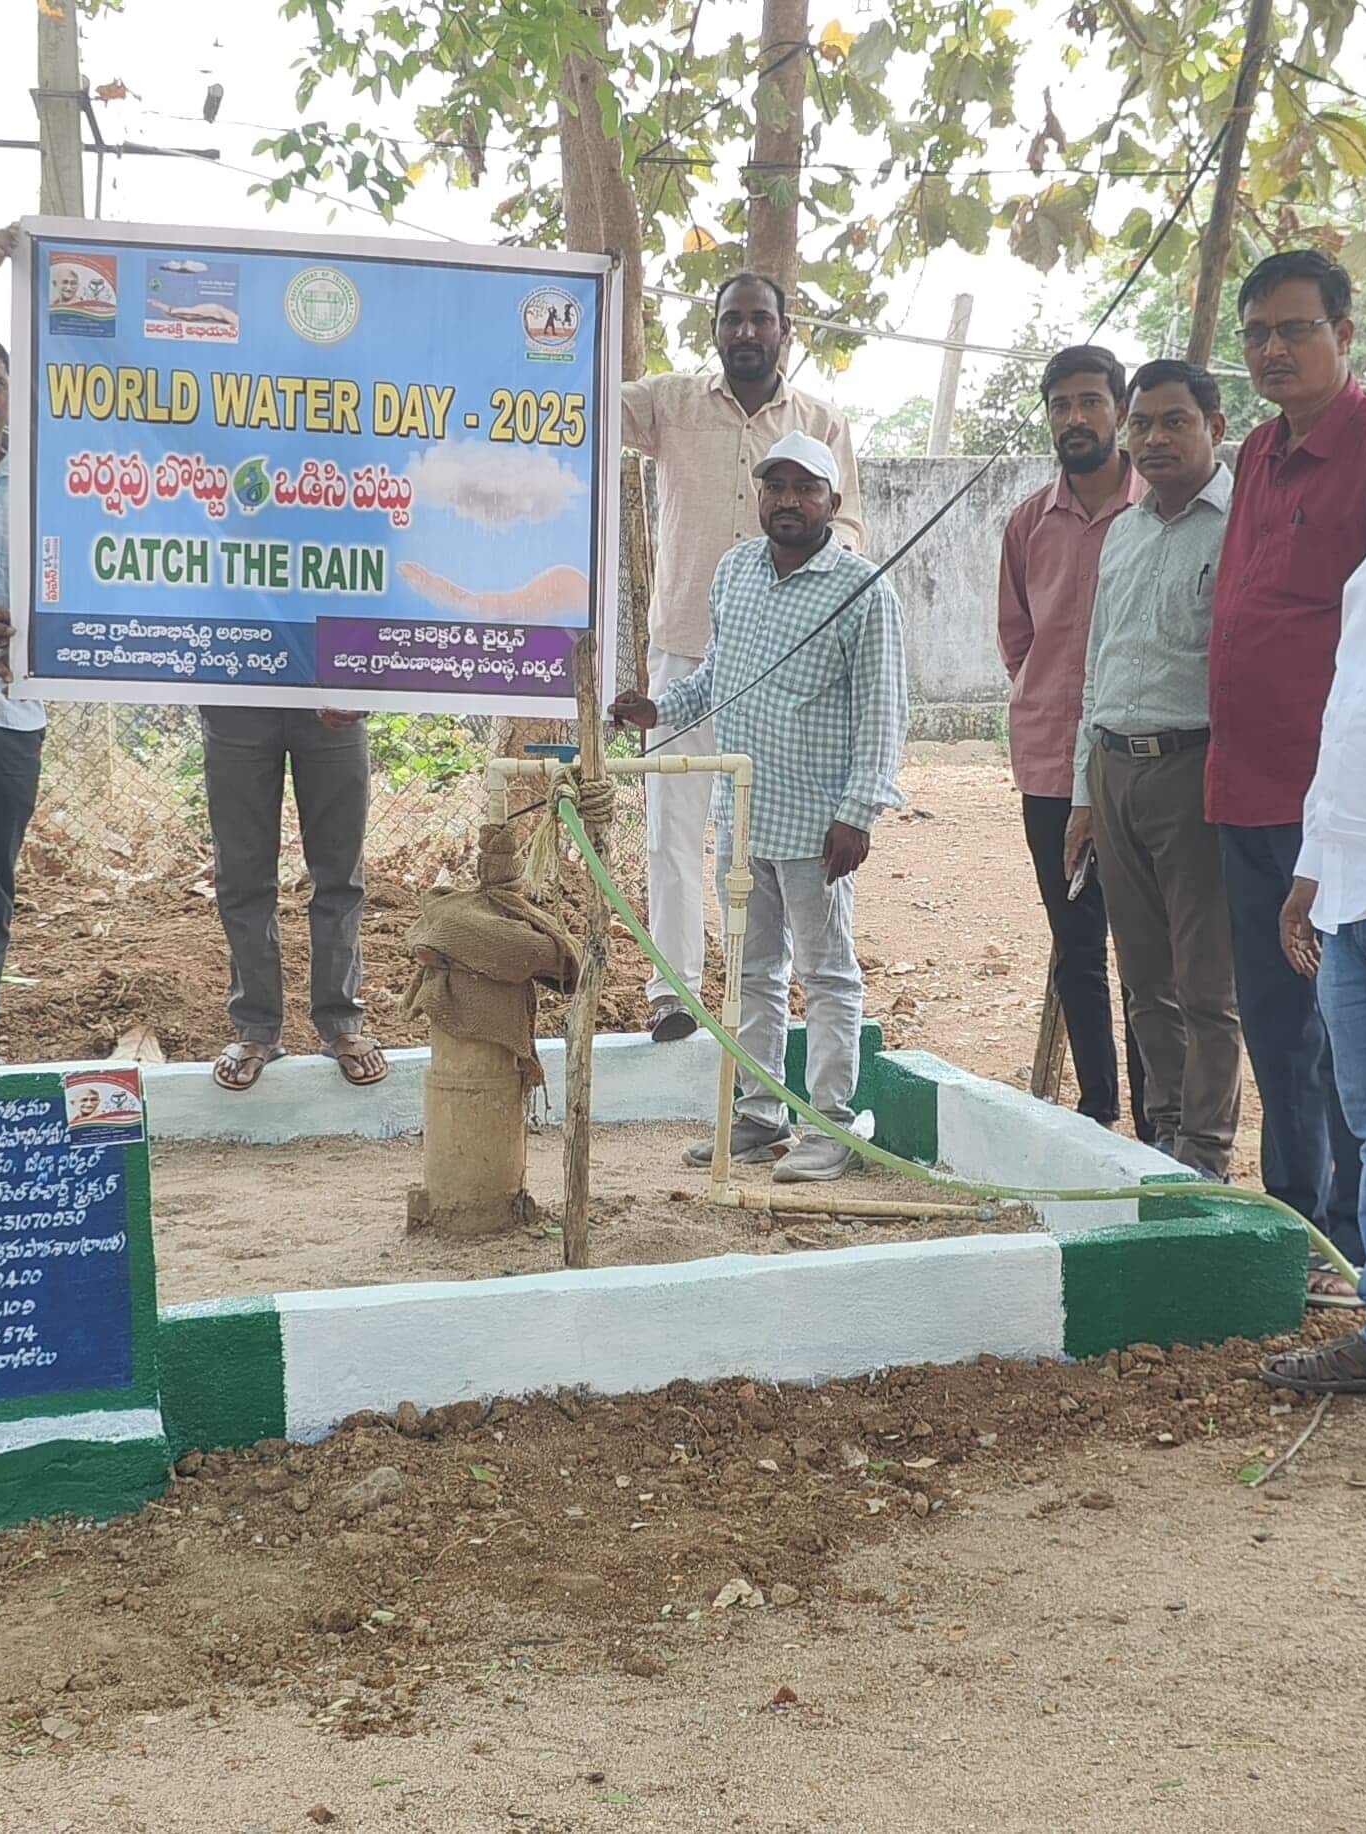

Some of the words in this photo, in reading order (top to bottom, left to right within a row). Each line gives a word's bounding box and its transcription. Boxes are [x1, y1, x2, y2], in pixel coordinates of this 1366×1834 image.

[46, 363, 198, 425] WORLD
[213, 371, 360, 433] WATER
[373, 381, 455, 440] DAY
[465, 411, 479, 428] -
[489, 389, 587, 447] 2025
[69, 454, 149, 515] వర్షపు
[156, 455, 228, 517] బొట్టు
[275, 462, 346, 507] ఒడిసి
[353, 467, 412, 526] పట్టు
[94, 536, 208, 584] CATCH
[220, 542, 289, 587] THE
[301, 546, 384, 592] RAIN
[72, 622, 106, 641] జిల్లా
[109, 622, 212, 650] గ్రామీణాభివృద్ధి
[216, 627, 273, 643] అధికారి
[378, 626, 411, 647] జిల్లా
[414, 625, 461, 649] కలెక్టర్
[463, 628, 479, 645] &
[482, 628, 525, 653] చైర్మన్
[56, 648, 91, 667] జిల్లా
[93, 646, 198, 677] గ్రామీణాభివృద్ధి
[247, 651, 288, 675] నిర్మల్
[334, 652, 367, 674] జిల్లా
[370, 651, 475, 681] గ్రామీణాభివృద్ధి
